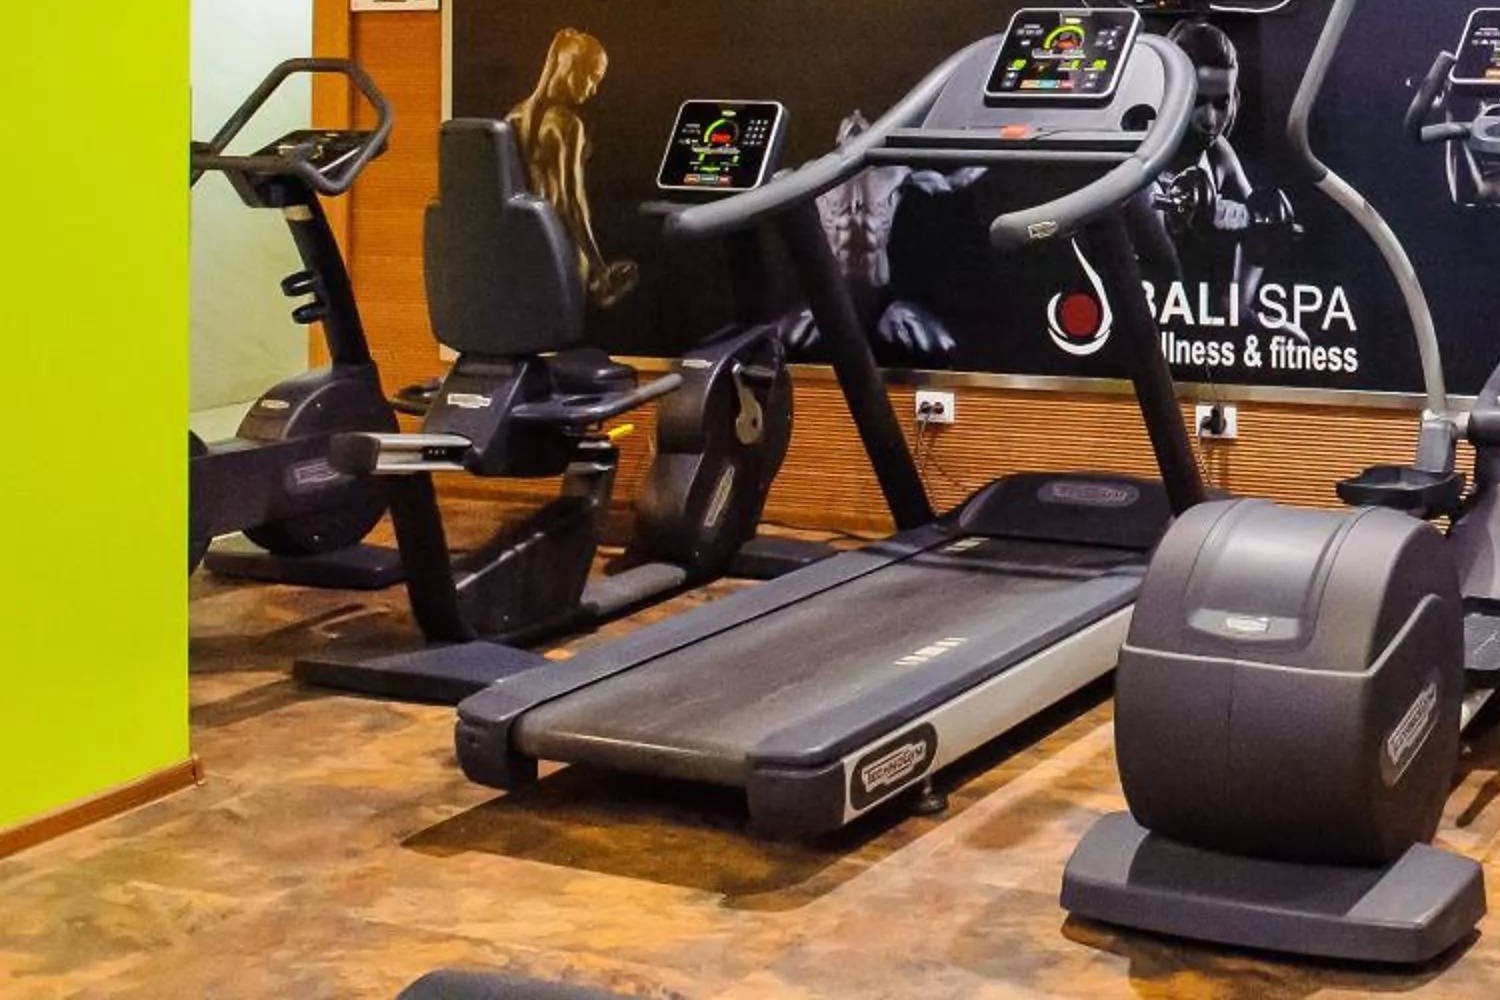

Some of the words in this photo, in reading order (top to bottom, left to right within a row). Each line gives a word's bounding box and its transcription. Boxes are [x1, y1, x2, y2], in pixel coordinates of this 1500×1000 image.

[1257, 283, 1358, 332] SPA
[1160, 331, 1236, 367] llness
[1243, 334, 1263, 368] &
[1269, 335, 1359, 373] fitness
